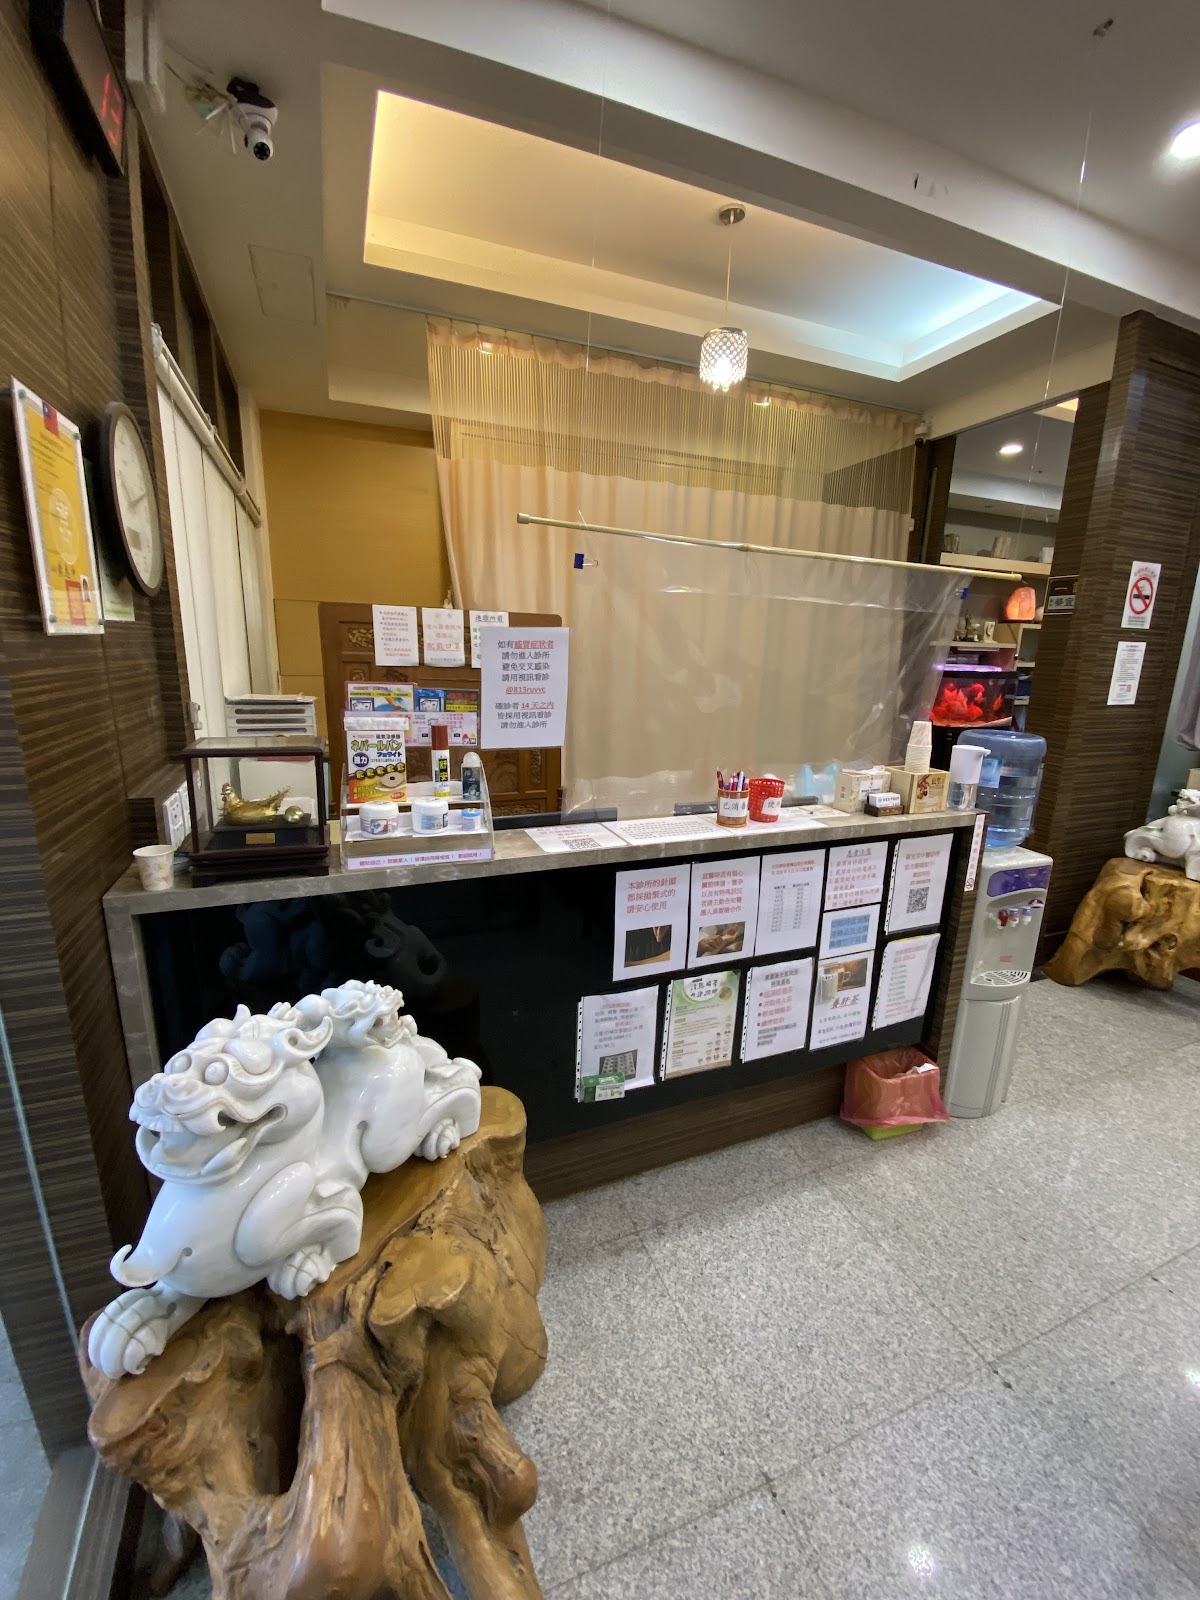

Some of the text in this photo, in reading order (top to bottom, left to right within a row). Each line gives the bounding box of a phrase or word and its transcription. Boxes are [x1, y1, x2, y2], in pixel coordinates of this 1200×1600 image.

[497, 640, 554, 649] 如有感冒症狀者
[502, 651, 550, 660] 請勿進入診所
[502, 662, 550, 671] 避免交叉感染
[501, 673, 550, 682] 請用視訊看診
[495, 702, 519, 710] 確診者
[531, 701, 555, 709] 天之內
[497, 711, 552, 720] 皆採用視訊看診
[500, 721, 547, 729] 請勿進入診所
[627, 877, 677, 890] 本診所的針頭
[627, 888, 676, 902] 都採拋棄式的
[626, 901, 667, 914] 請安心使用
[832, 994, 860, 1008] 養肝茶
